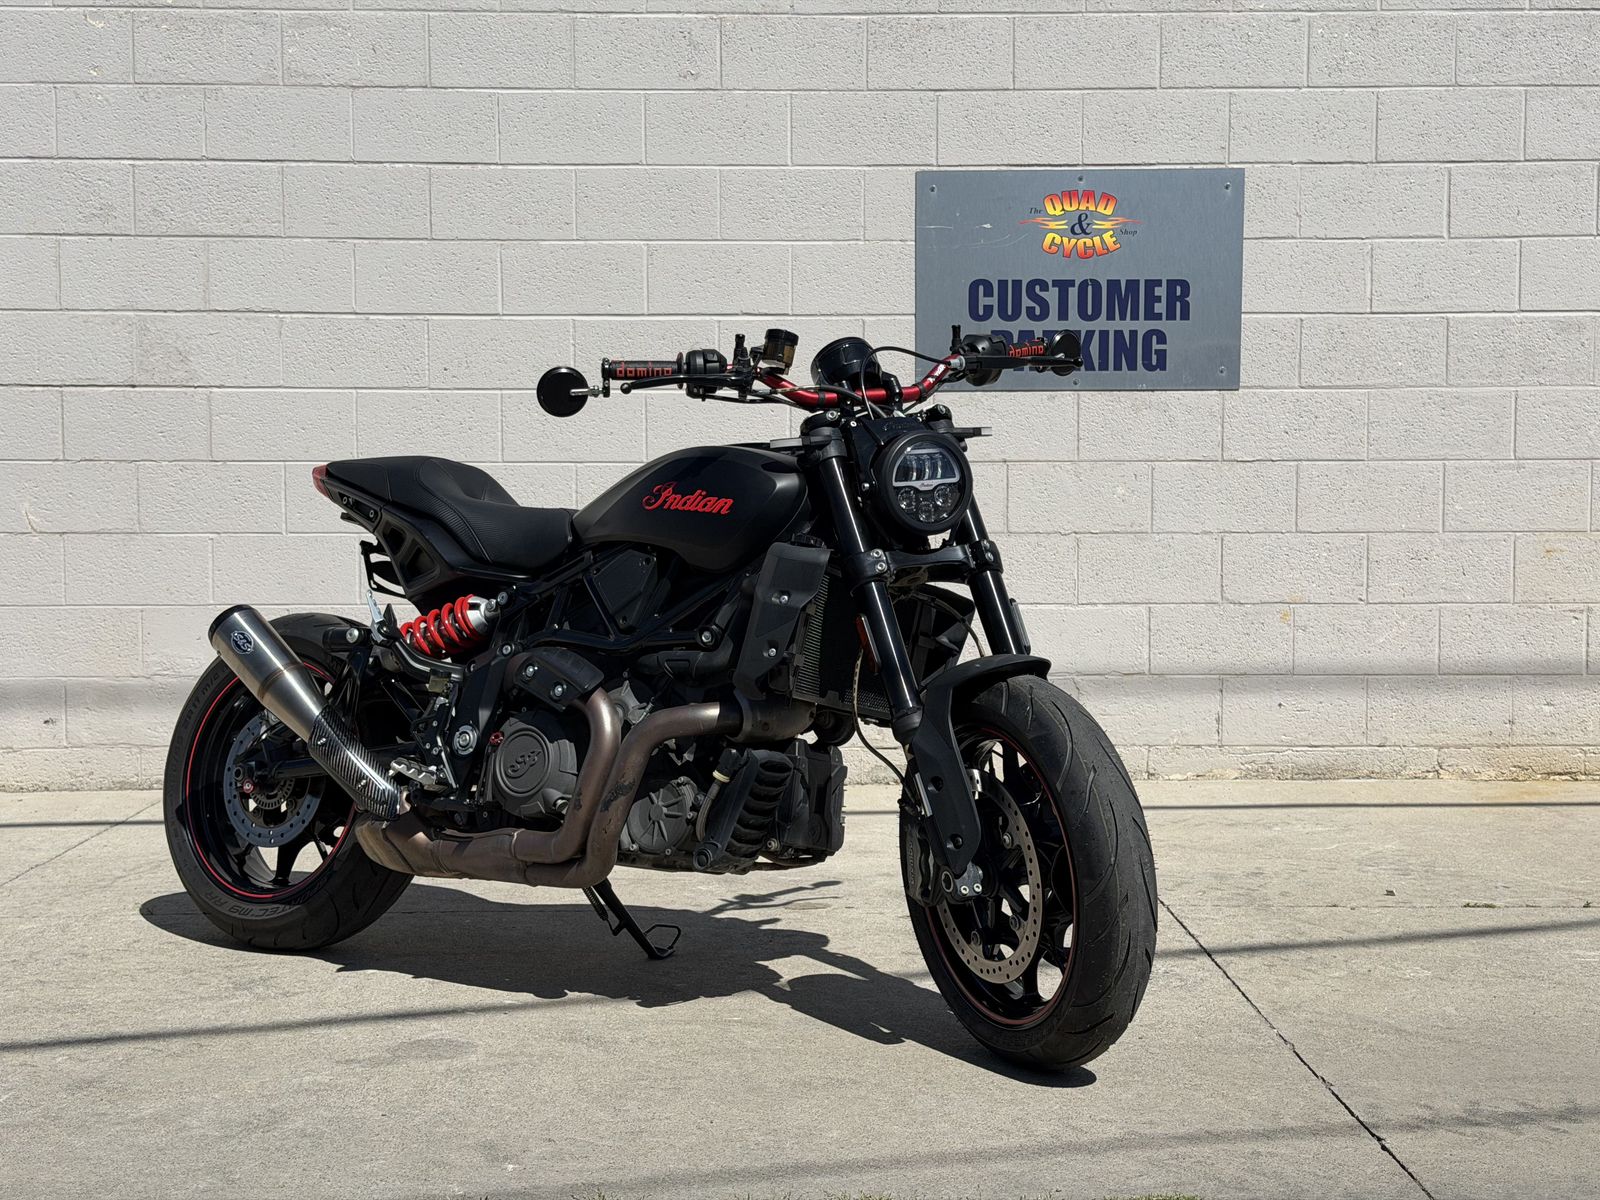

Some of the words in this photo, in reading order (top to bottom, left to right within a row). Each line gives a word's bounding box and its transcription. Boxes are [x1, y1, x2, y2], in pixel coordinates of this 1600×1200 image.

[1029, 207, 1042, 215] The
[1043, 189, 1118, 216] QUAD
[1070, 212, 1093, 236] &
[1119, 228, 1138, 237] Shop
[1042, 230, 1121, 259] CYCLE
[968, 278, 1191, 322] CUSTOMER
[991, 329, 1168, 373] KING
[1008, 343, 1044, 357] domino
[616, 361, 672, 377] domino
[642, 481, 734, 515] Indian
